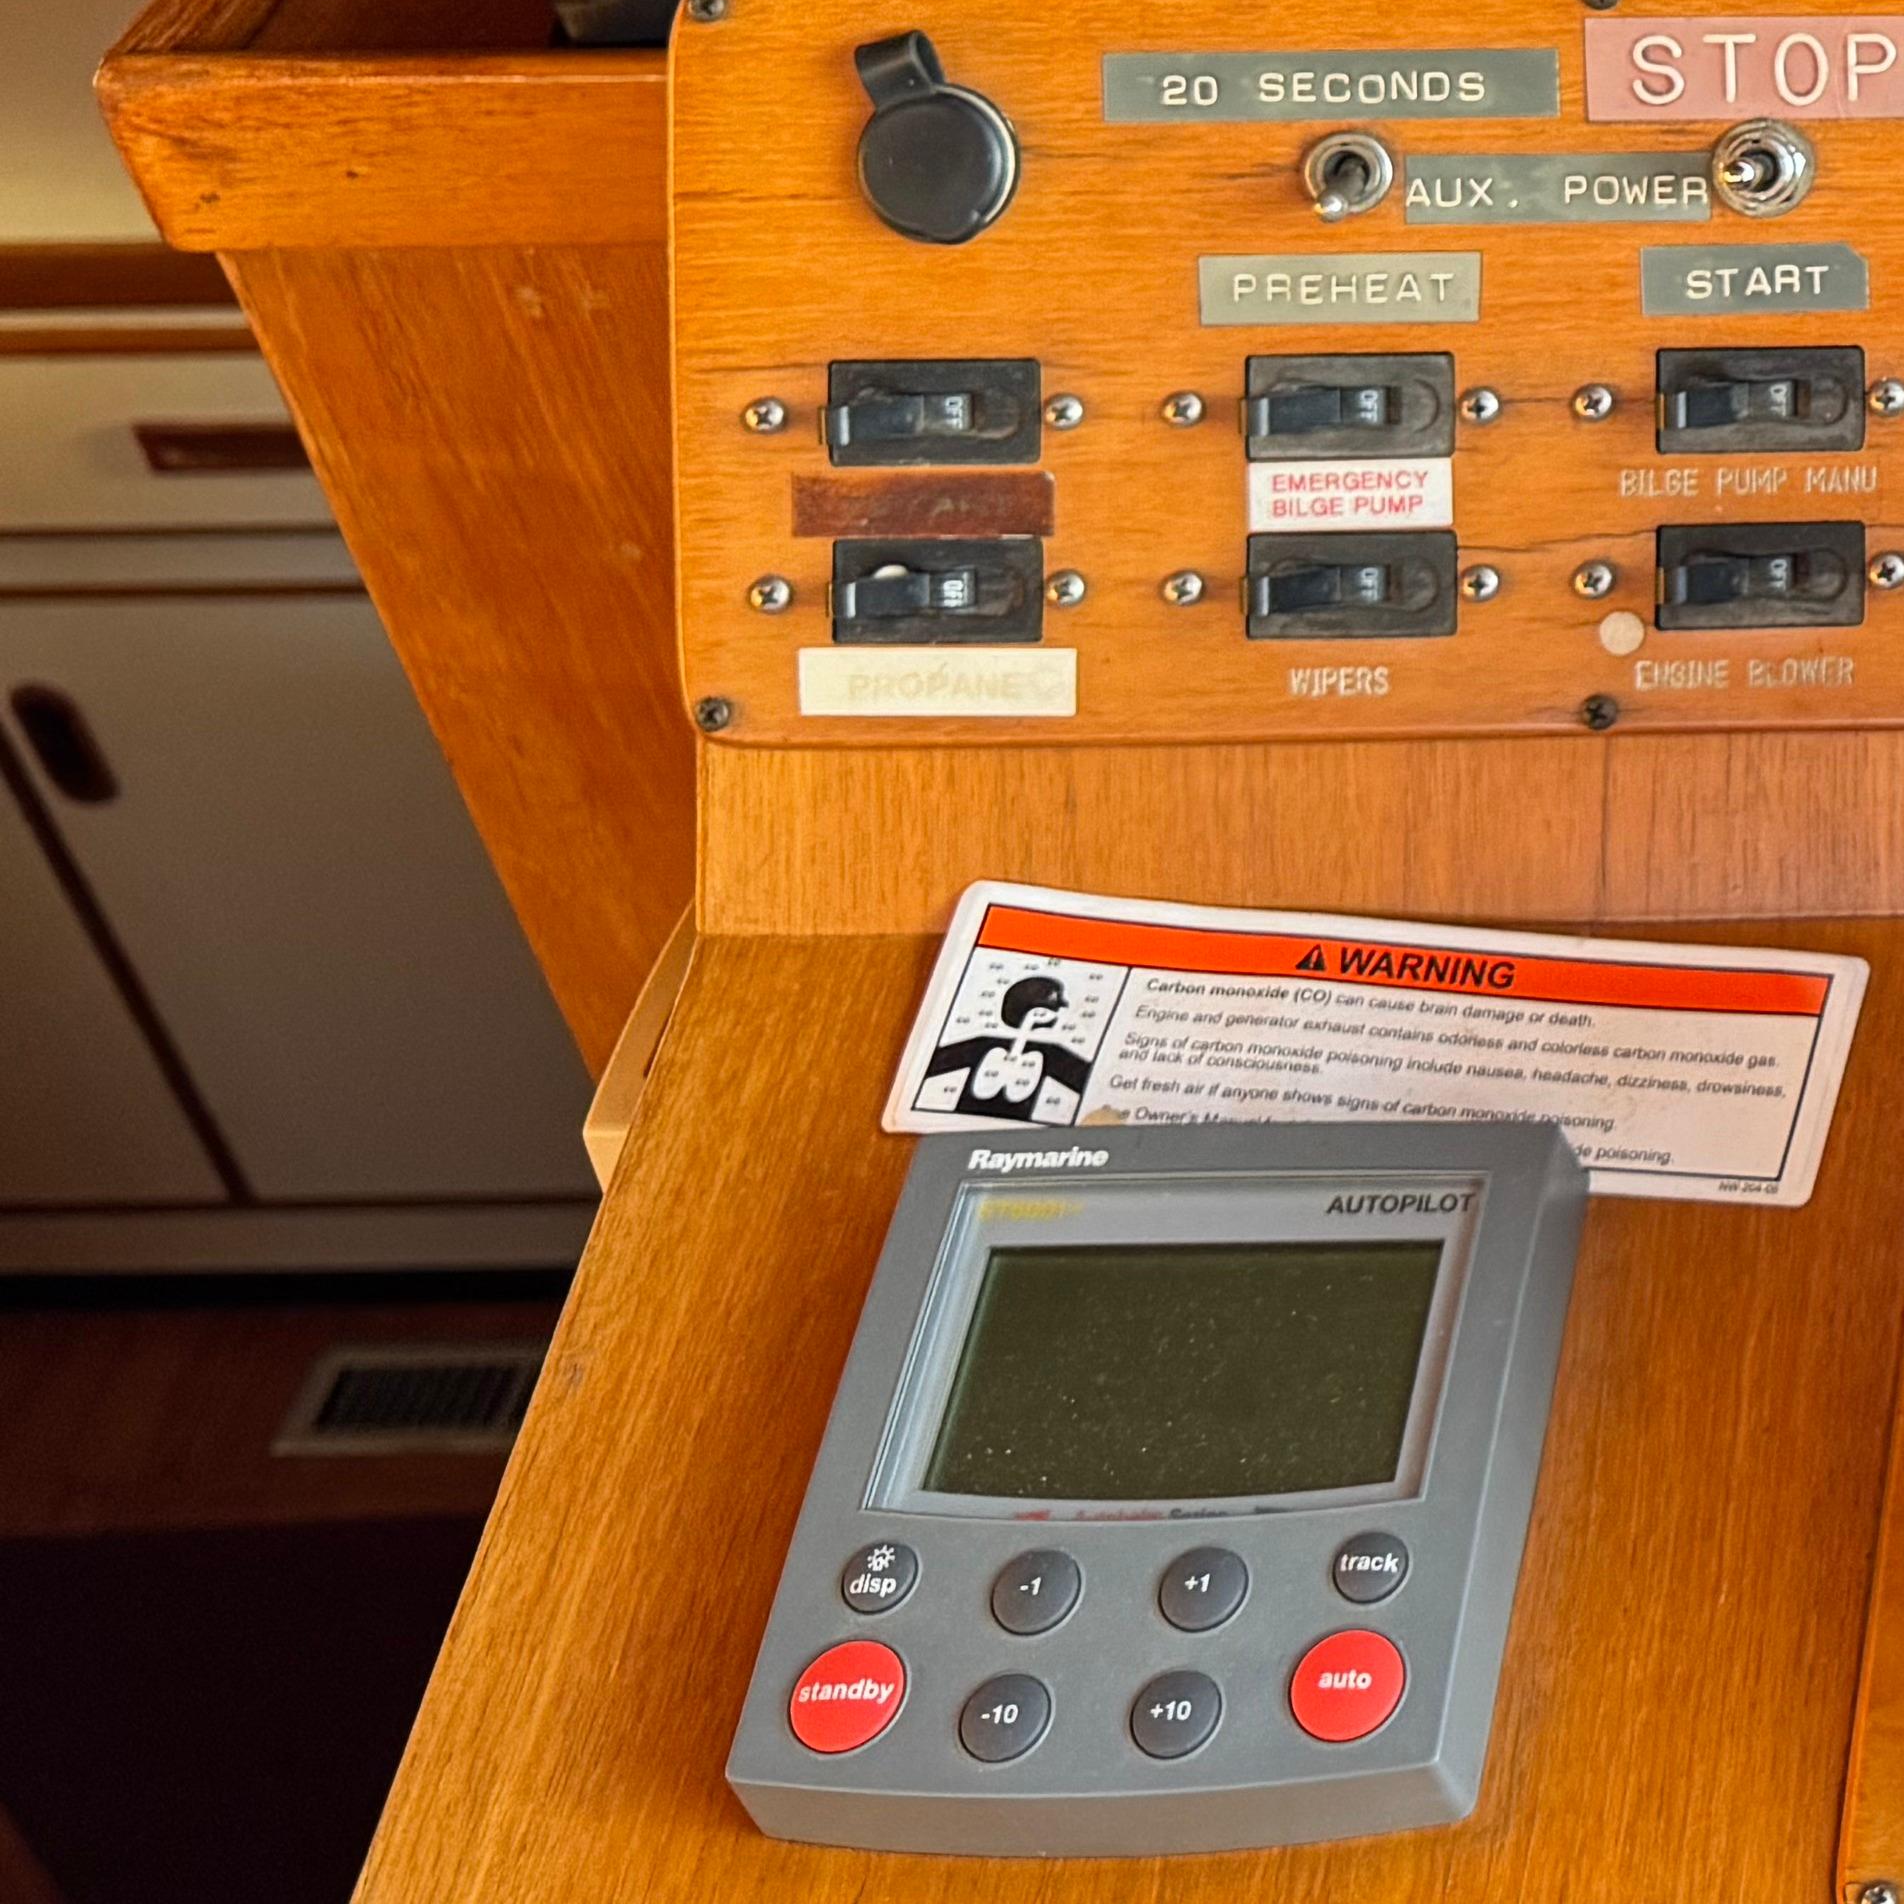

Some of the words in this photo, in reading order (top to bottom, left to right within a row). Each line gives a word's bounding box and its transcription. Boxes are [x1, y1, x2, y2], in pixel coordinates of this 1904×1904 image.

[1631, 32, 1897, 107] STOP
[1161, 74, 1219, 106] 20
[1258, 71, 1486, 104] SECONDS
[1405, 176, 1519, 208] AUX.
[1564, 174, 1709, 207] POWER
[1232, 270, 1455, 306] PREHEAT
[1685, 264, 1829, 299] START
[1271, 470, 1428, 492] EMERGENCY
[1620, 469, 1699, 498] BILGE
[1716, 467, 1789, 496] PUMP
[1805, 466, 1878, 494] MANU
[1271, 496, 1348, 517] BILGE
[1354, 495, 1424, 516] PUMP
[849, 672, 1024, 701] PROPANE
[1288, 666, 1390, 697] WIPERS
[1635, 659, 1730, 692] ENGINE
[1748, 657, 1855, 686] BLOWER
[1337, 945, 1517, 991] WARNING
[1147, 977, 1206, 996] Carbon
[1210, 983, 1290, 1000] monoxide
[1294, 986, 1332, 1007] (CO)
[1335, 992, 1365, 1008] can
[1368, 995, 1415, 1011] cause
[1419, 998, 1458, 1016] brain
[1462, 1003, 1525, 1024] damage
[1528, 1009, 1546, 1023] or
[1548, 1010, 1597, 1028] death.
[968, 1147, 1109, 1173] Raymarine
[1326, 1192, 1476, 1215] AUTOPILOT
[1339, 1551, 1398, 1573] track
[849, 1573, 896, 1599] disp
[1018, 1578, 1042, 1596] -1
[1184, 1574, 1211, 1593] +1
[798, 1678, 895, 1705] standby
[1318, 1669, 1372, 1690] auto
[980, 1705, 1018, 1725] -10
[1149, 1702, 1192, 1721] +10
